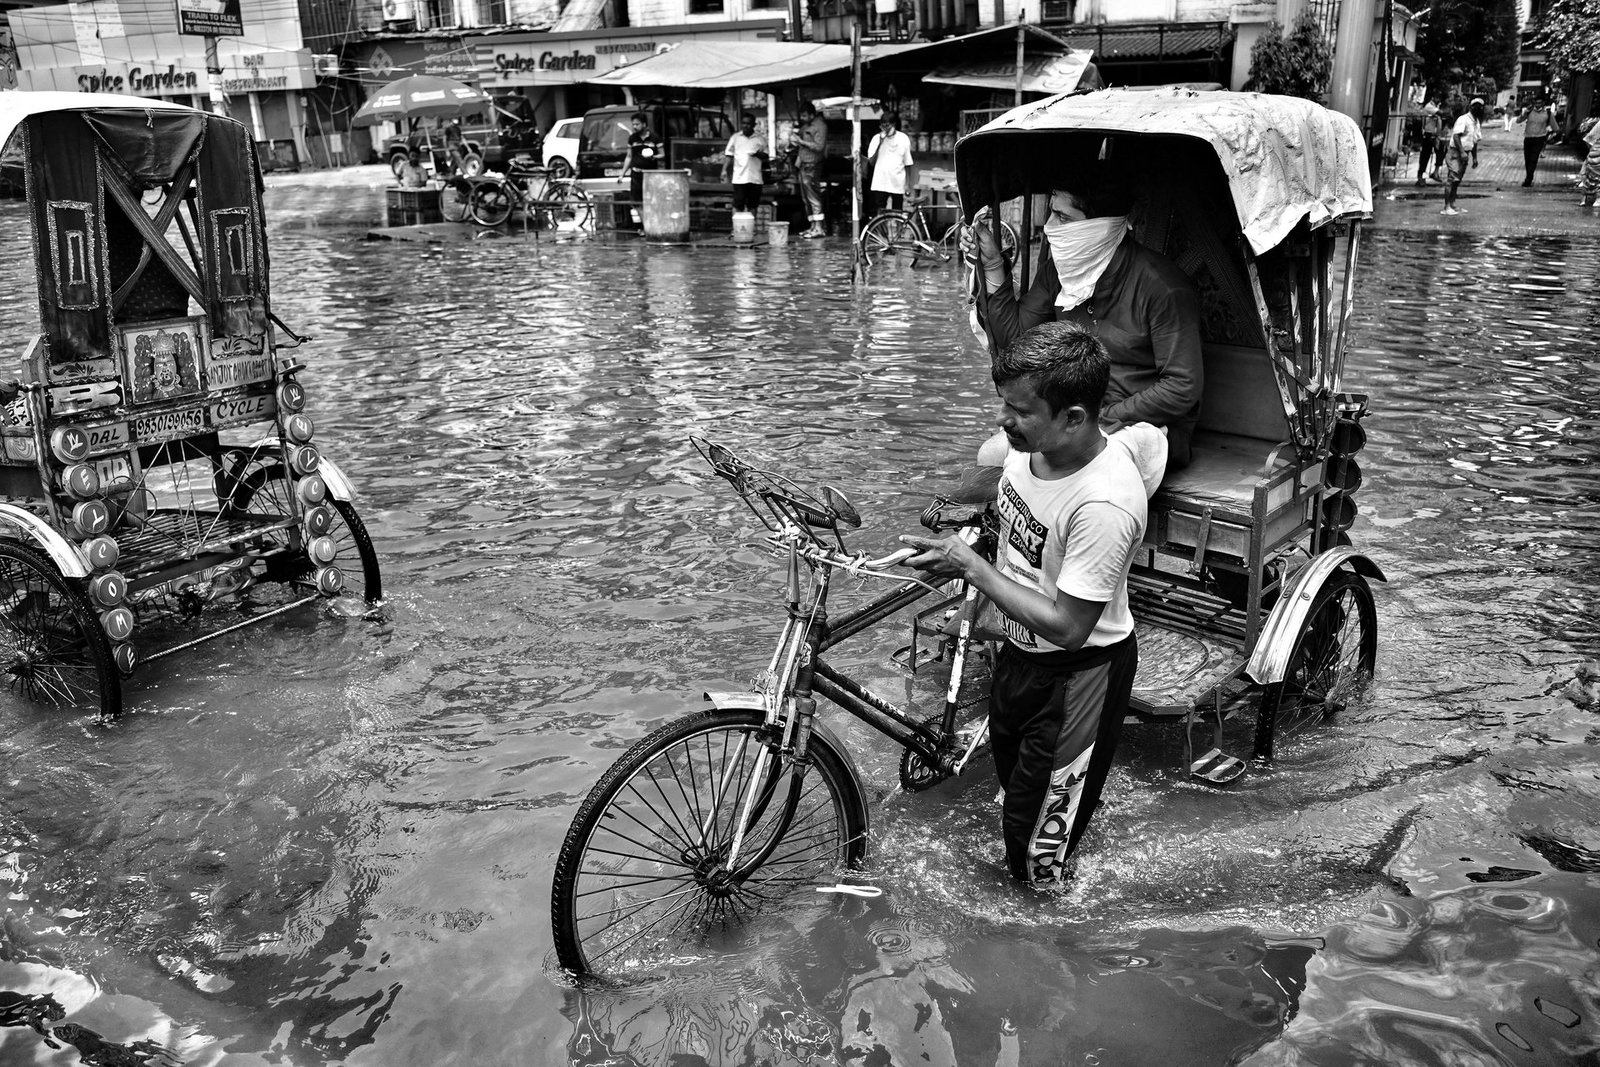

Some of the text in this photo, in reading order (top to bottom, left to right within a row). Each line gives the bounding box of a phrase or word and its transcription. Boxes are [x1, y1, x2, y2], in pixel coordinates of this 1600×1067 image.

[209, 13, 219, 21] TO
[595, 42, 656, 54] RESTAURANT
[495, 50, 596, 80] Spice Garden
[78, 64, 198, 93] Spice Garden
[216, 398, 268, 419] CYCLE
[137, 410, 202, 436] 9830199056
[90, 428, 120, 446] DAL
